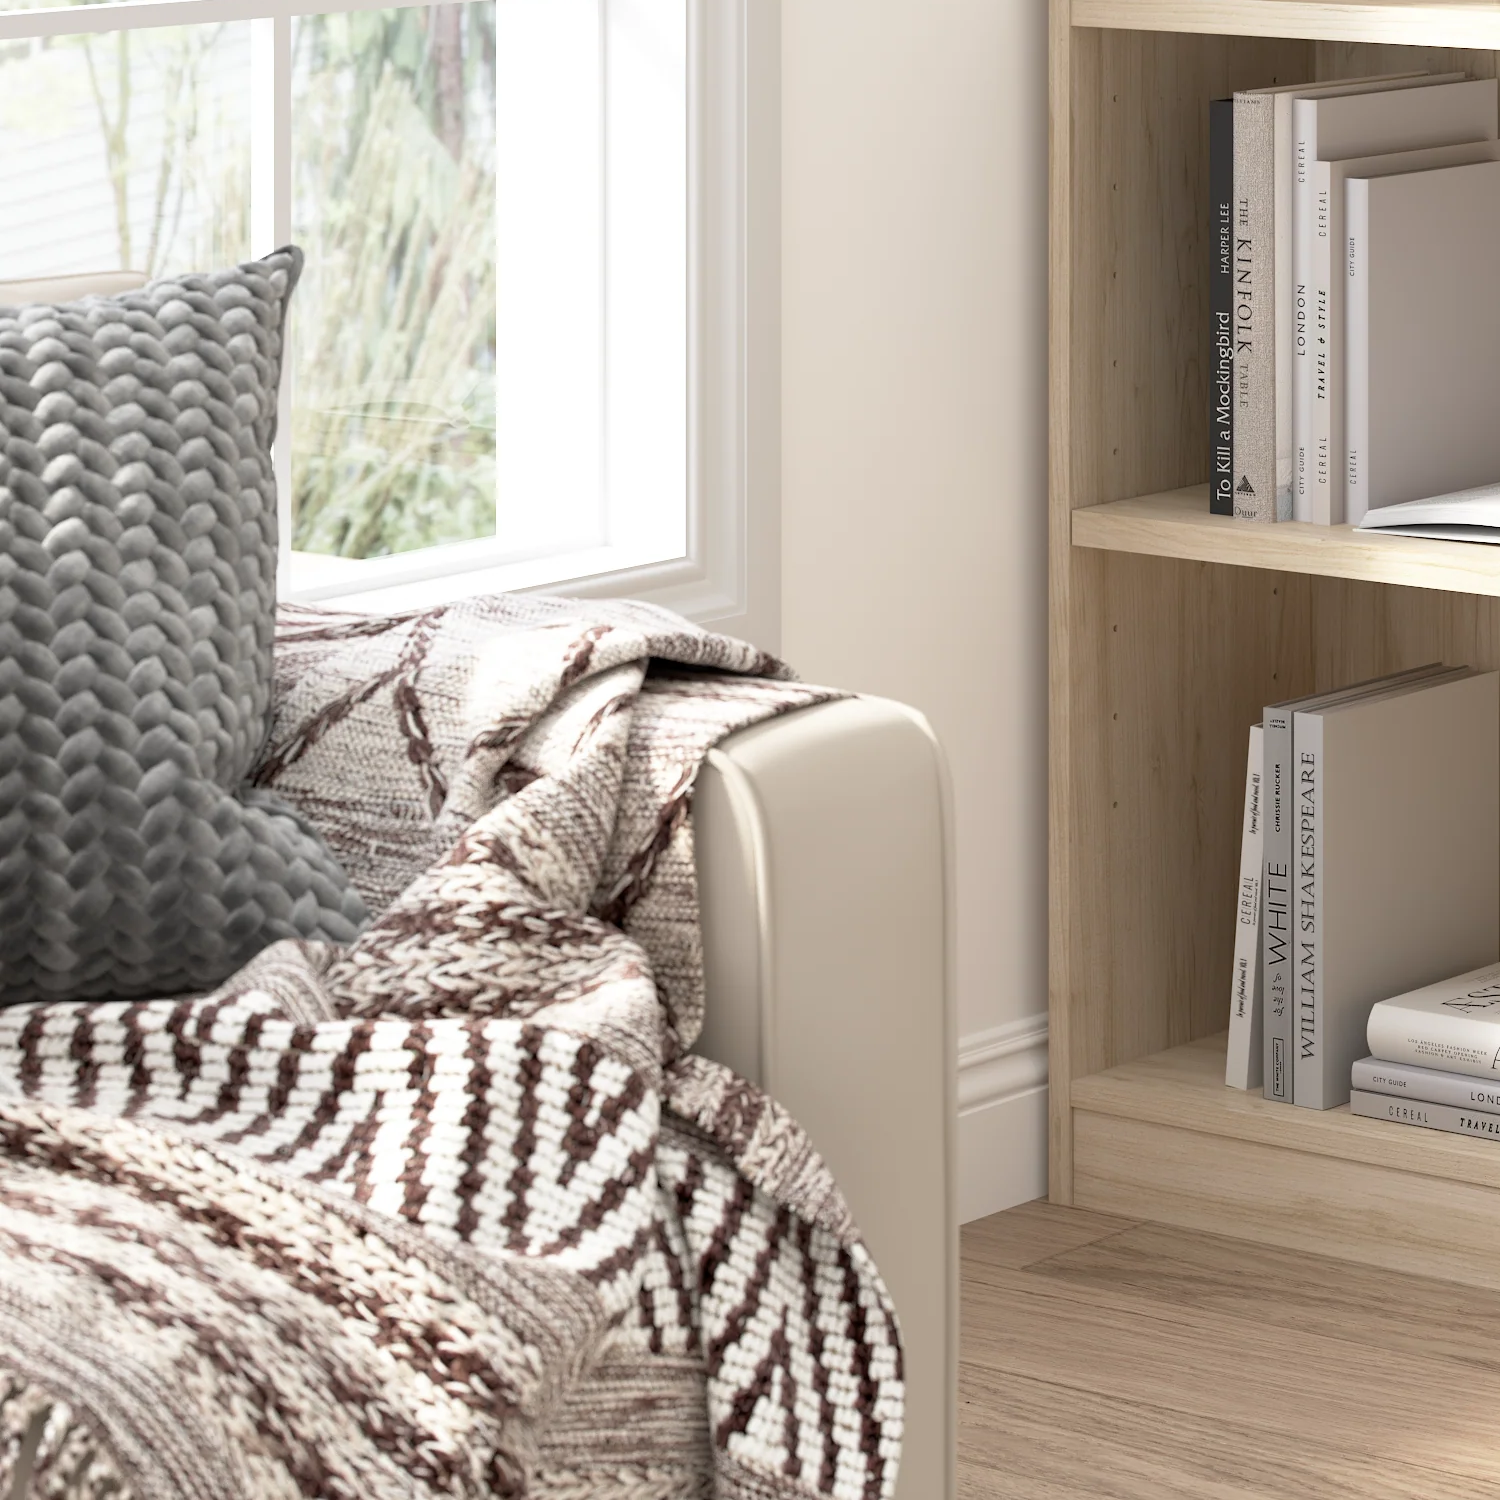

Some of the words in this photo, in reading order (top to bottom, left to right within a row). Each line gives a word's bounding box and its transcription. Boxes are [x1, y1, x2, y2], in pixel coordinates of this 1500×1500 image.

[1239, 199, 1248, 226] THE
[1237, 237, 1252, 354] KINFOLK
[1216, 311, 1234, 423] Mockingbird
[1240, 363, 1248, 408] TABLE
[1220, 430, 1230, 441] a
[1216, 444, 1230, 473] Kill
[1218, 477, 1230, 500] To
[1269, 862, 1287, 965] WHITE
[1372, 1077, 1386, 1085] CITY
[1389, 1079, 1407, 1087] GUIDE
[1389, 1105, 1428, 1123] CEREAL
[1459, 1118, 1500, 1134] TRAVEL
